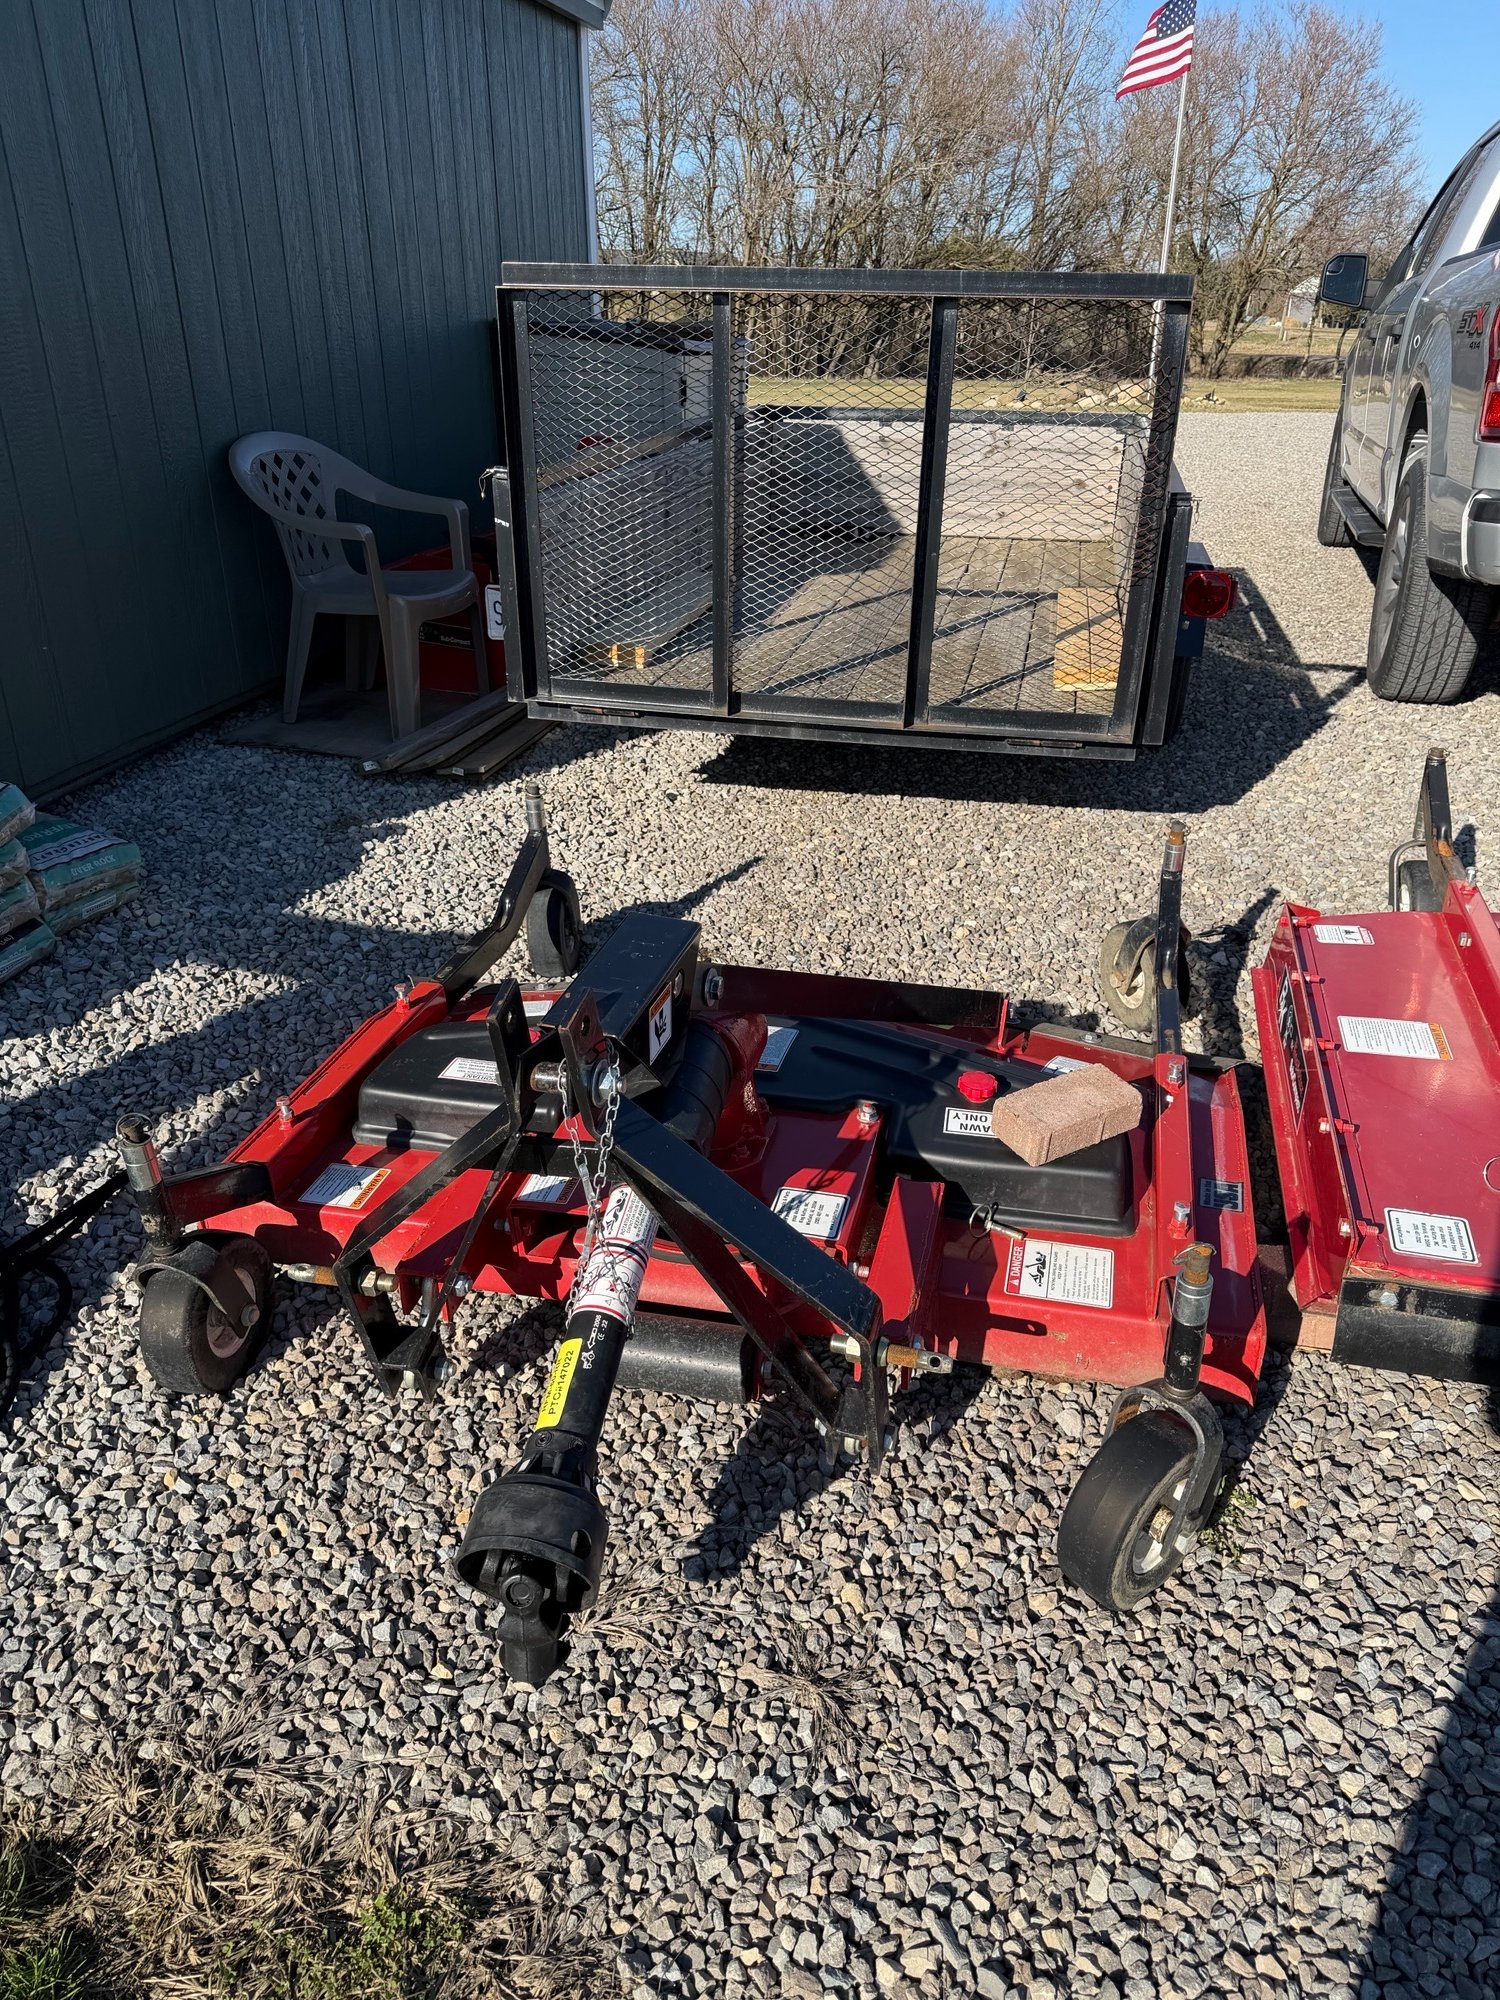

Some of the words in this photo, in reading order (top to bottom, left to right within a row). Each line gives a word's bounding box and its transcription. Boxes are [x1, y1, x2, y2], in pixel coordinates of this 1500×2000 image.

[953, 1112, 988, 1122] ONLY
[959, 1123, 991, 1133] AWN
[1010, 1246, 1023, 1277] DANGER
